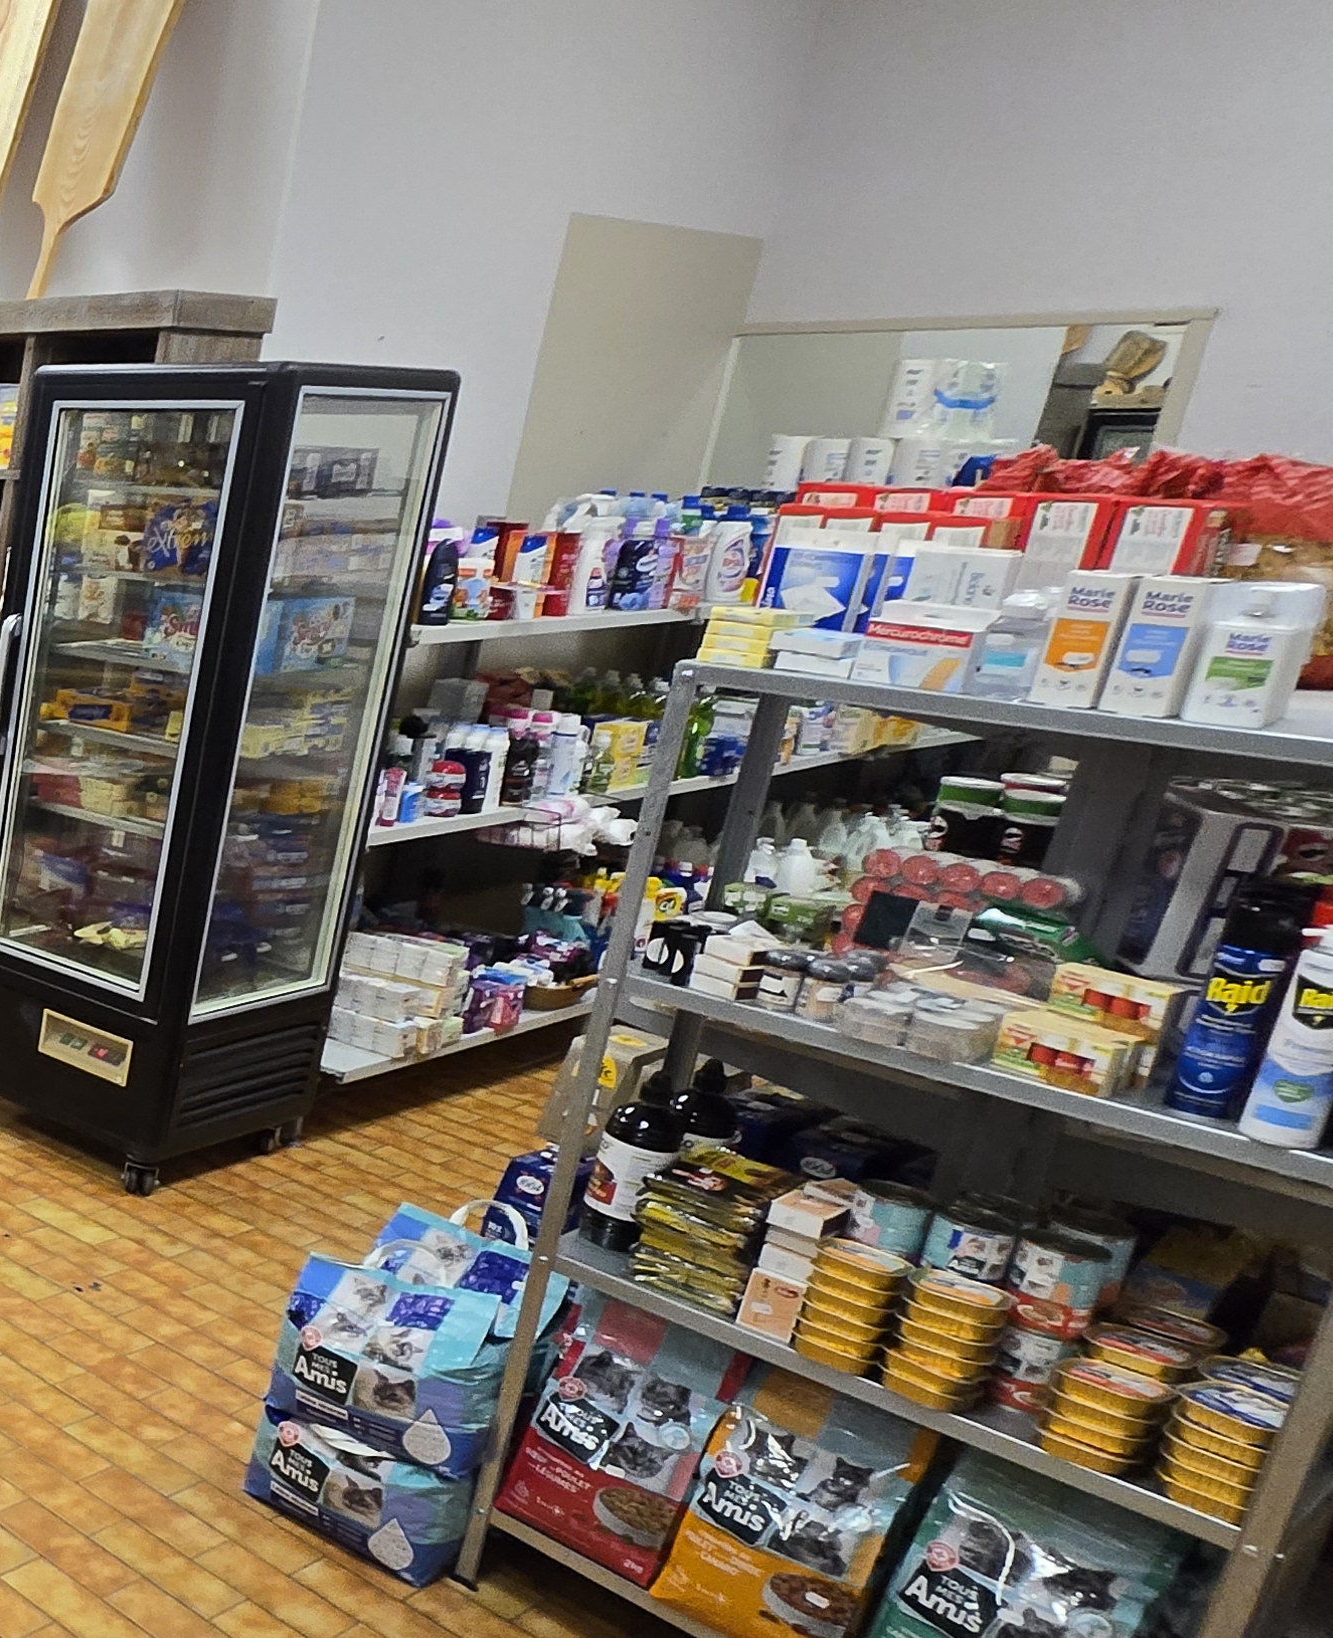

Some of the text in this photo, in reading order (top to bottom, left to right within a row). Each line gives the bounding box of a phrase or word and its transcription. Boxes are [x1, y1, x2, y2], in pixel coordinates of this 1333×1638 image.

[1071, 586, 1116, 599] Marie
[1146, 590, 1194, 603] Marie
[1229, 632, 1273, 643] Marie
[1206, 976, 1273, 1006] Raid
[1299, 988, 1333, 1009] Rai
[294, 1354, 347, 1394] Amis
[312, 1352, 338, 1369] TOUS
[540, 1405, 600, 1451] Amis
[271, 1449, 319, 1493] Amis
[702, 1481, 766, 1532] Amis
[941, 1574, 979, 1601] TOUS
[904, 1574, 984, 1634] Amis
